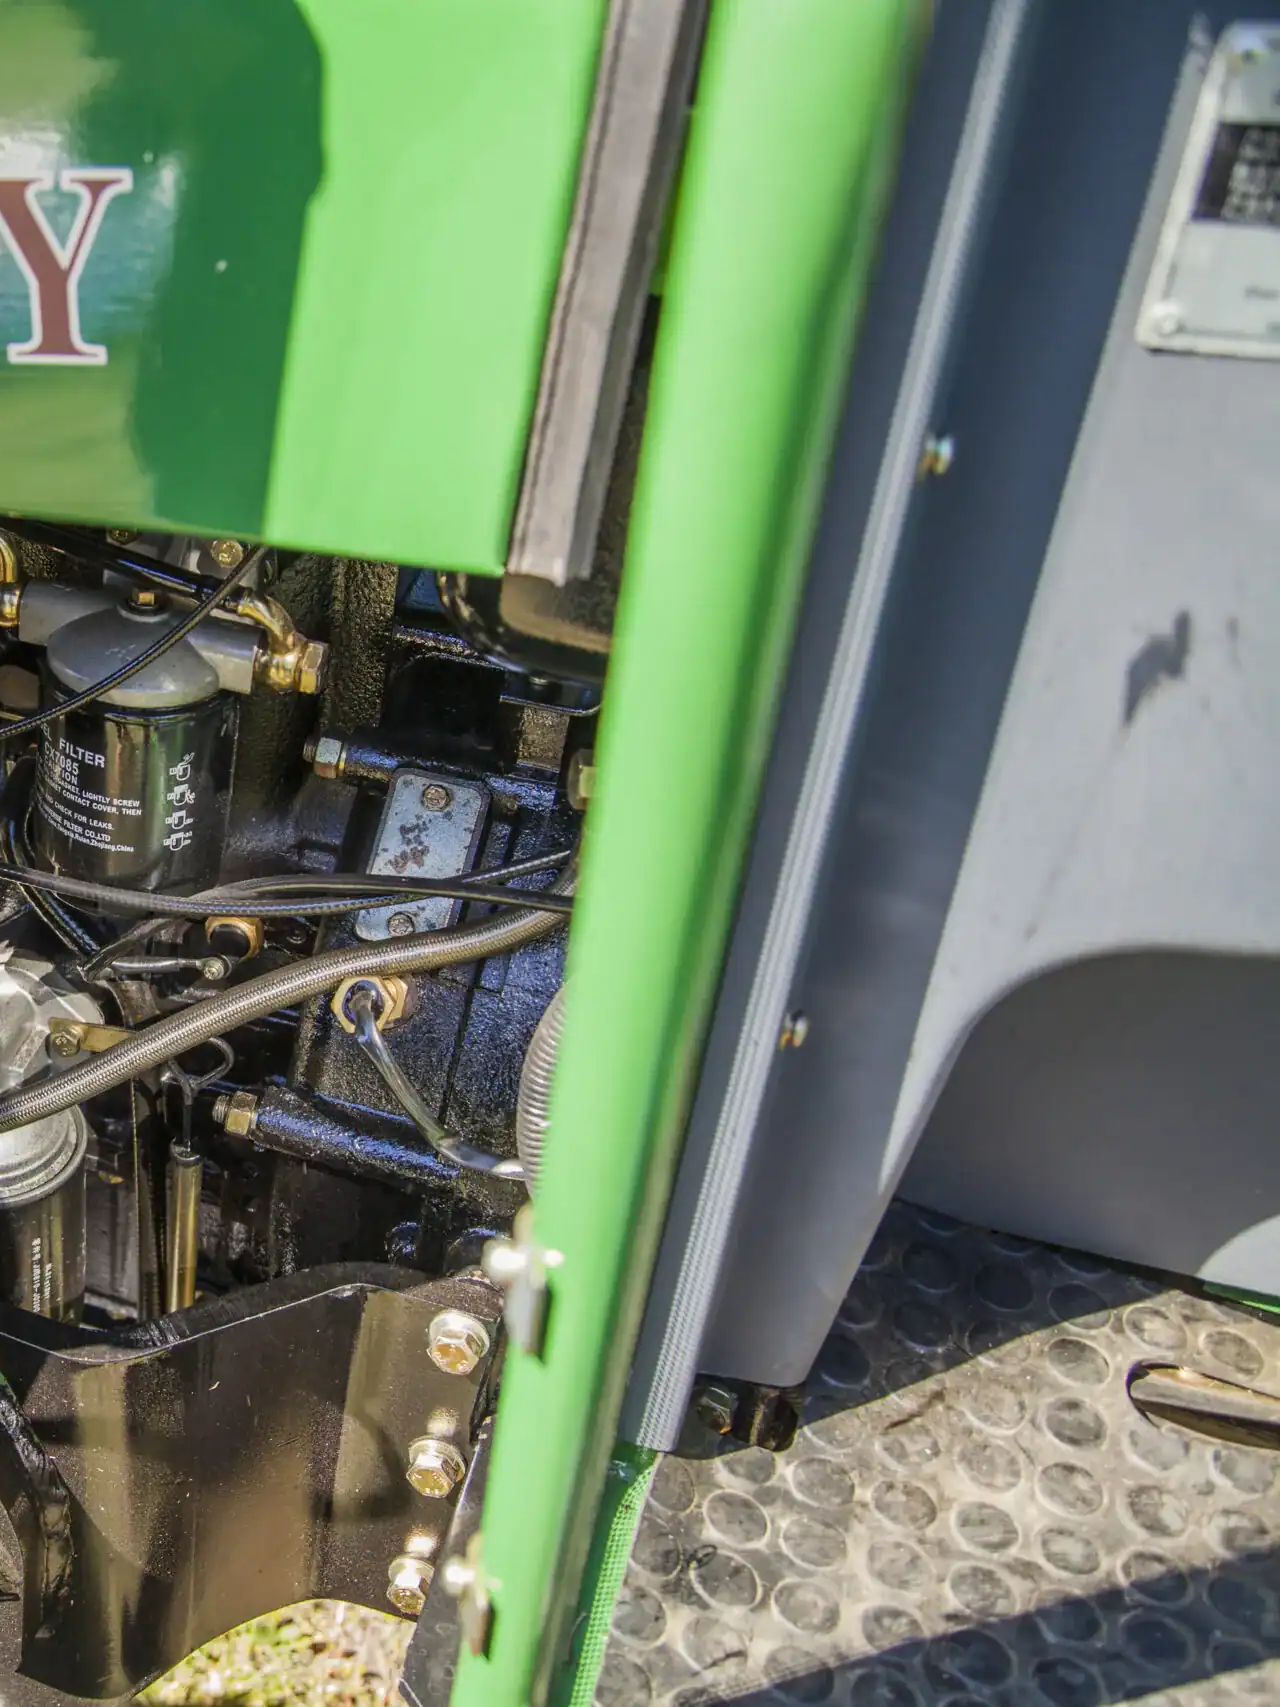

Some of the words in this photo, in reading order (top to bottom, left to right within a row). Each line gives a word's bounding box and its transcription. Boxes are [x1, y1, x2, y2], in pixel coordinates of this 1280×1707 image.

[44, 741, 79, 776] CX7085
[59, 737, 105, 769] FILTER
[62, 789, 90, 807] CONTACT
[92, 802, 119, 815] COVER,
[122, 808, 142, 816] THEN
[82, 790, 111, 805] LIGHTLY
[112, 798, 140, 808] SCREW
[54, 801, 73, 817] CHECK
[73, 812, 87, 823] FOR
[89, 818, 115, 831] LEAKS.
[63, 819, 83, 834] FILTER
